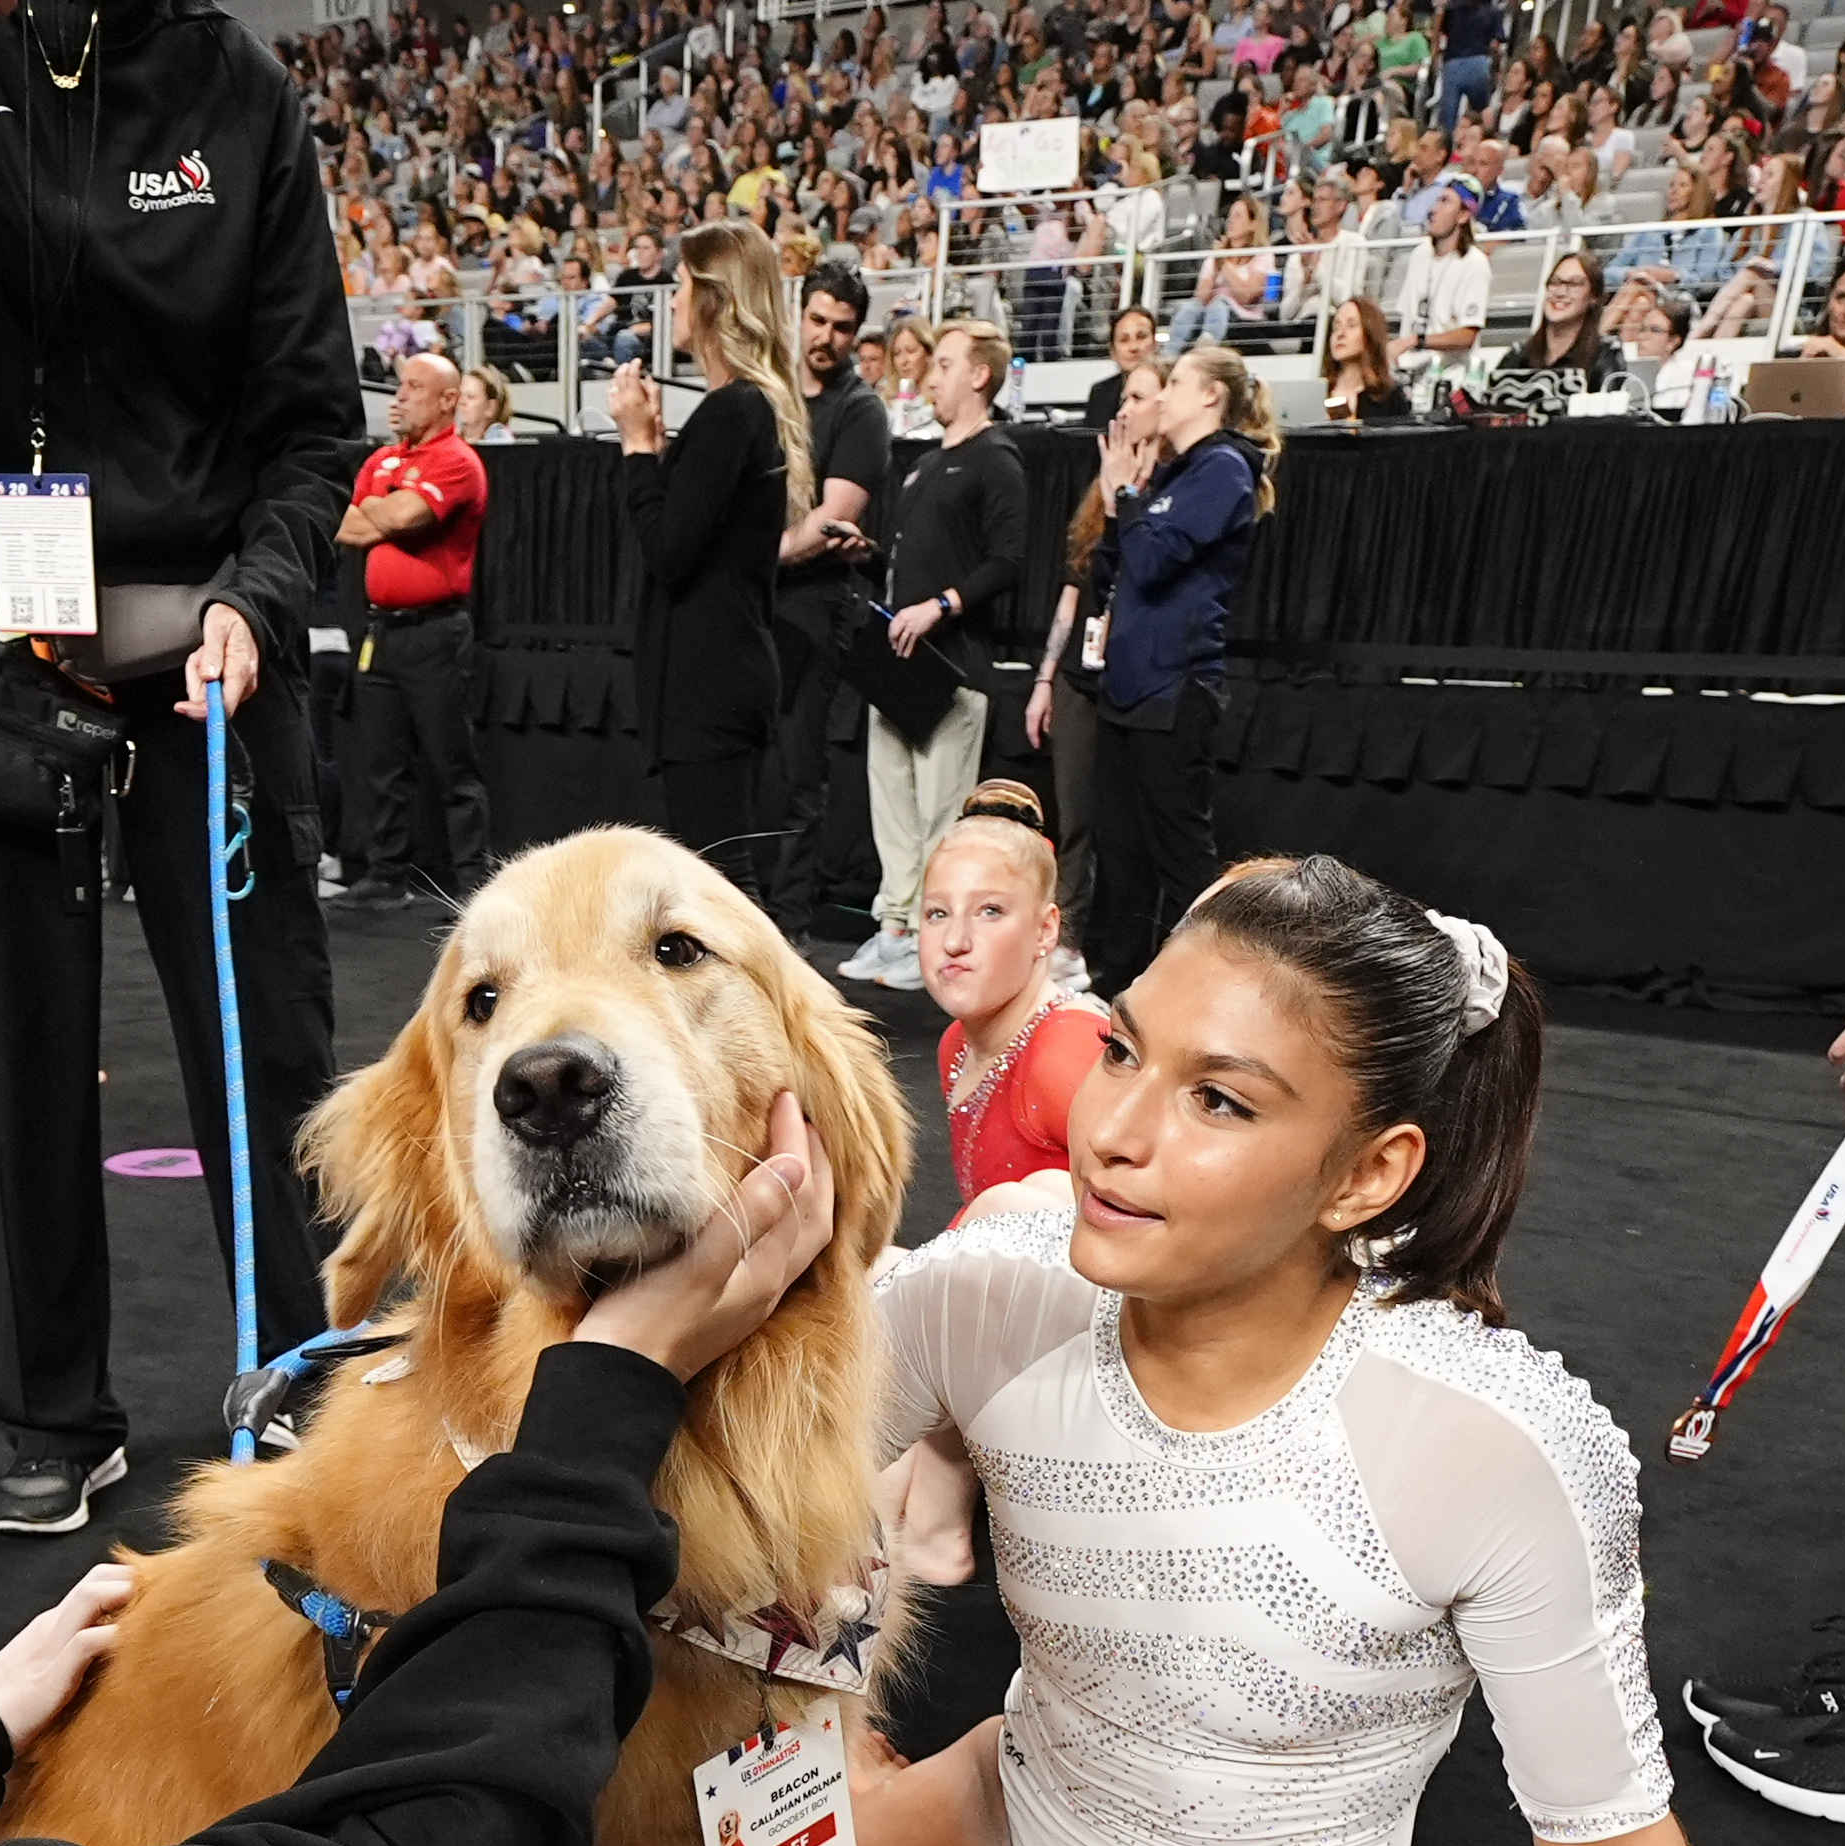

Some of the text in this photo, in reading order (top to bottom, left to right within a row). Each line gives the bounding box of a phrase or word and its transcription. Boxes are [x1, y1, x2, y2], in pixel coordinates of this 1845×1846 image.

[128, 170, 182, 197] USA
[128, 190, 216, 213] Gymnastics
[8, 482, 71, 497] 20 24
[740, 1740, 801, 1783] US GYMNASTICS
[750, 1771, 842, 1832] CALLAHAN MOLNAR
[770, 1767, 819, 1803] BEACON
[768, 1795, 829, 1837] GOODEST BOY
